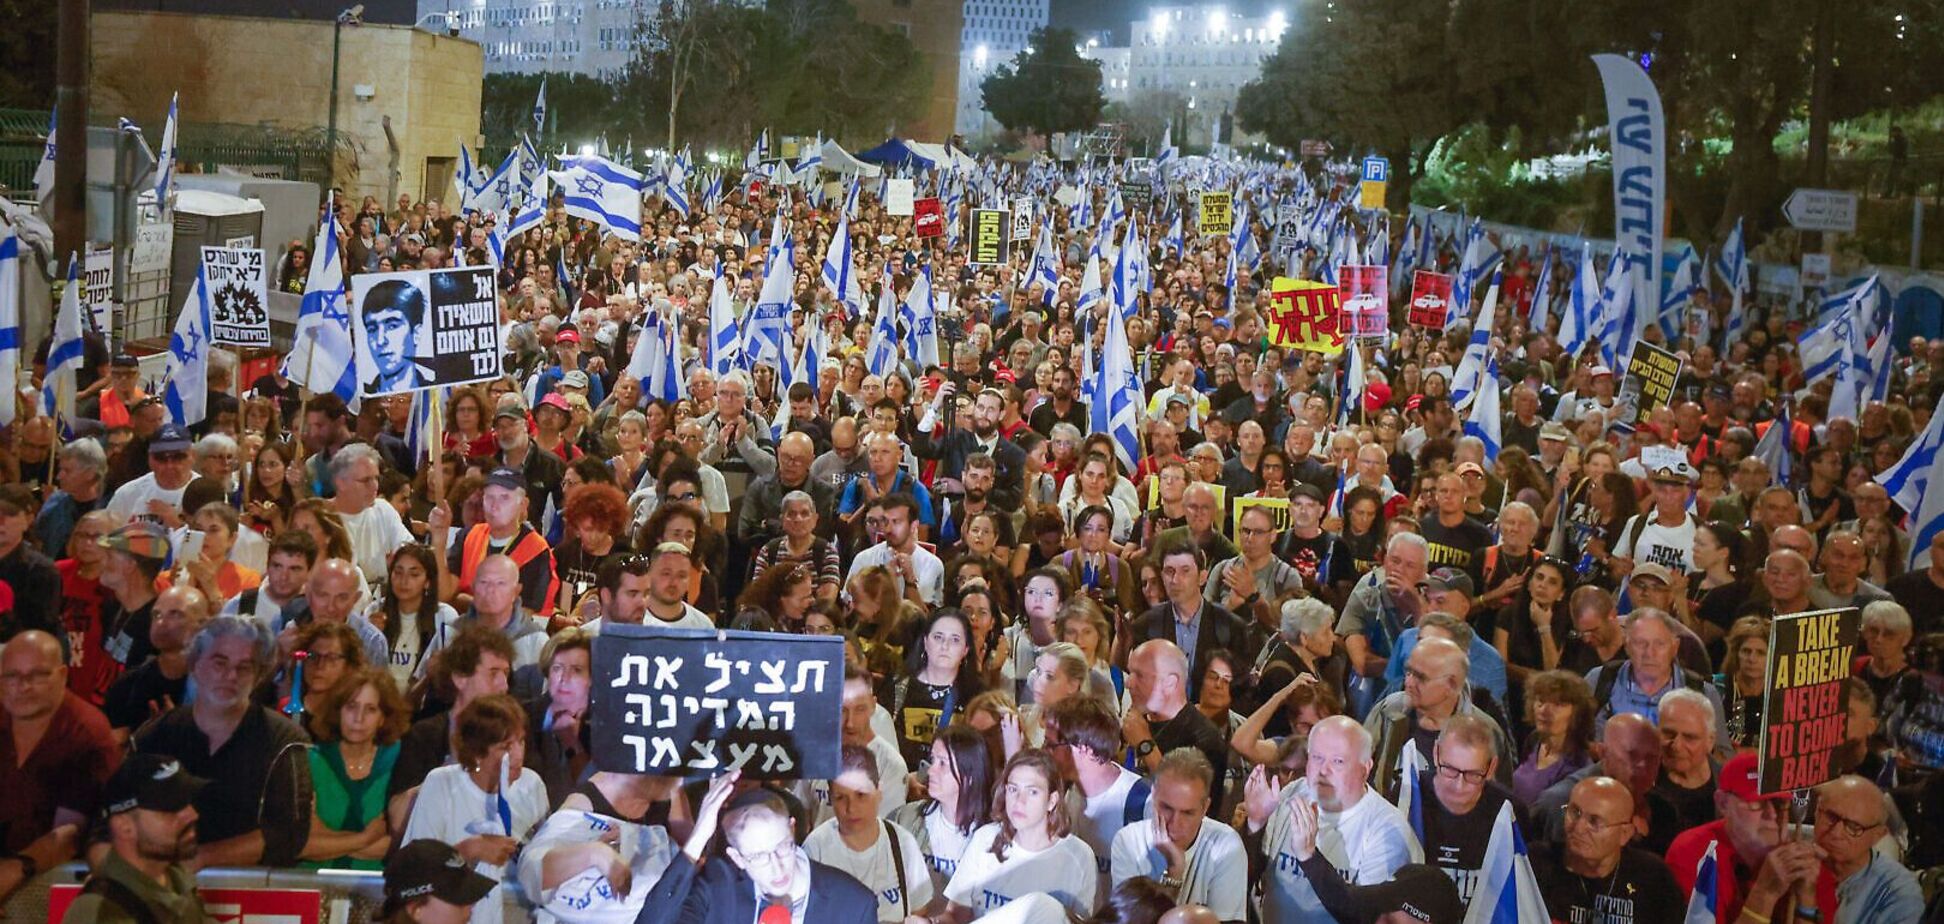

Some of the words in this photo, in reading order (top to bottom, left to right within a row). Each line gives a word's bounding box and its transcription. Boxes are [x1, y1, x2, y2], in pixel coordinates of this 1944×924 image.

[205, 250, 239, 264] שהרס
[241, 252, 262, 265] מי
[236, 267, 261, 281] לא
[473, 273, 493, 299] אל
[438, 301, 494, 328] תשאירו
[436, 328, 475, 355] אותם
[478, 326, 496, 350] גם
[470, 349, 497, 376] לבד
[1797, 613, 1840, 652] TAKE
[610, 653, 683, 690] את
[704, 652, 830, 694] תציל
[1775, 655, 1788, 689] A
[1793, 645, 1853, 688] BREAK
[624, 693, 796, 731] המדינה
[1783, 682, 1841, 723] NEVER
[1769, 723, 1795, 759] TO
[1799, 713, 1846, 753] COME
[622, 734, 794, 773] מעצמך
[1781, 749, 1833, 790] BACK
[111, 798, 138, 813] POLICE
[401, 883, 433, 898] POLICE
[1401, 901, 1430, 921] משטרה
